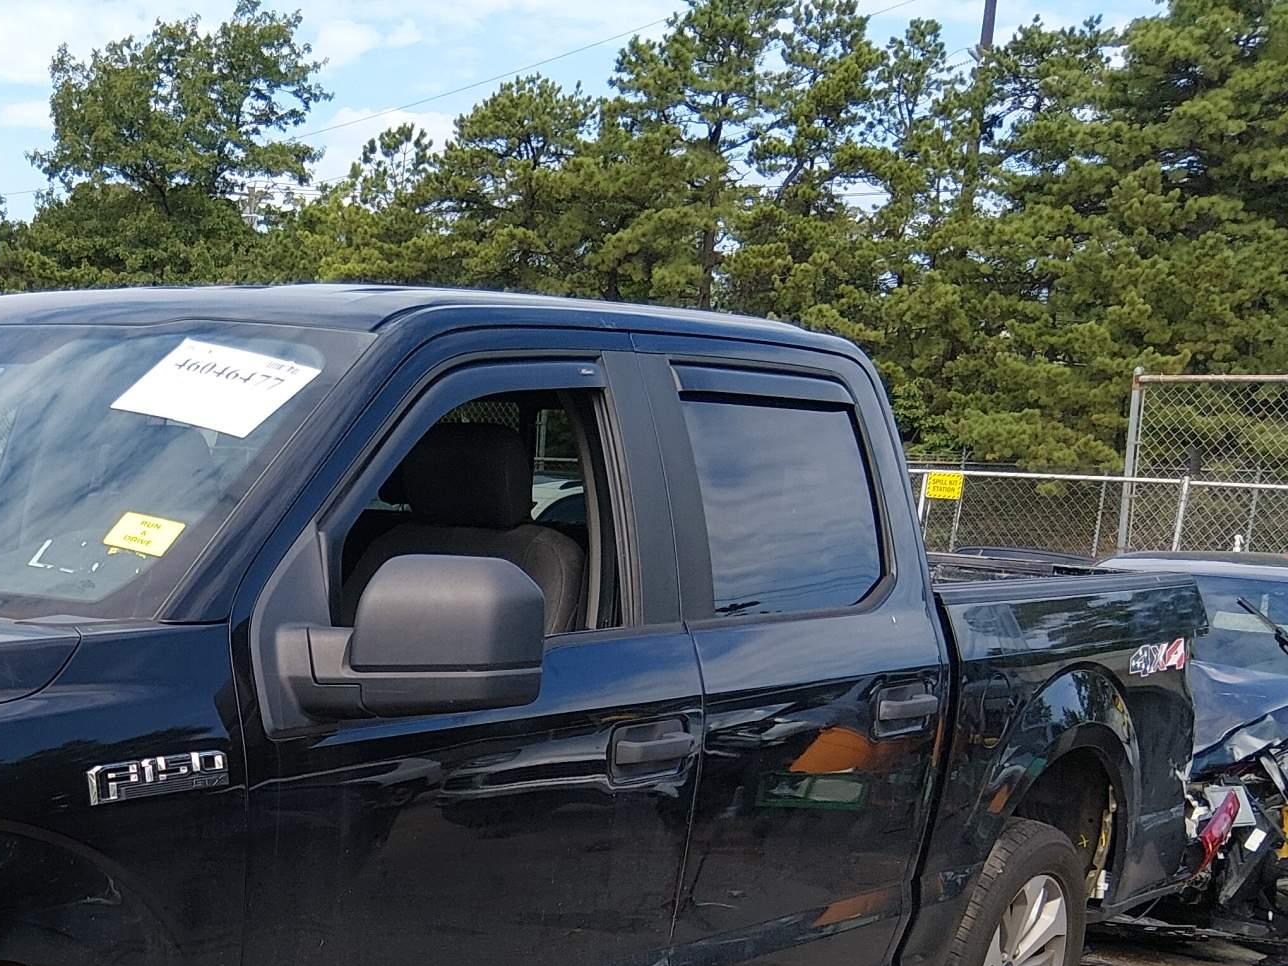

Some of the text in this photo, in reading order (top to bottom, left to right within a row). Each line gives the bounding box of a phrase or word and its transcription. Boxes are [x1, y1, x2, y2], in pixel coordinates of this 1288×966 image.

[175, 357, 285, 390] 46046477
[932, 485, 956, 493] STATION
[140, 520, 162, 530] RUN
[123, 533, 152, 546] DRIVE
